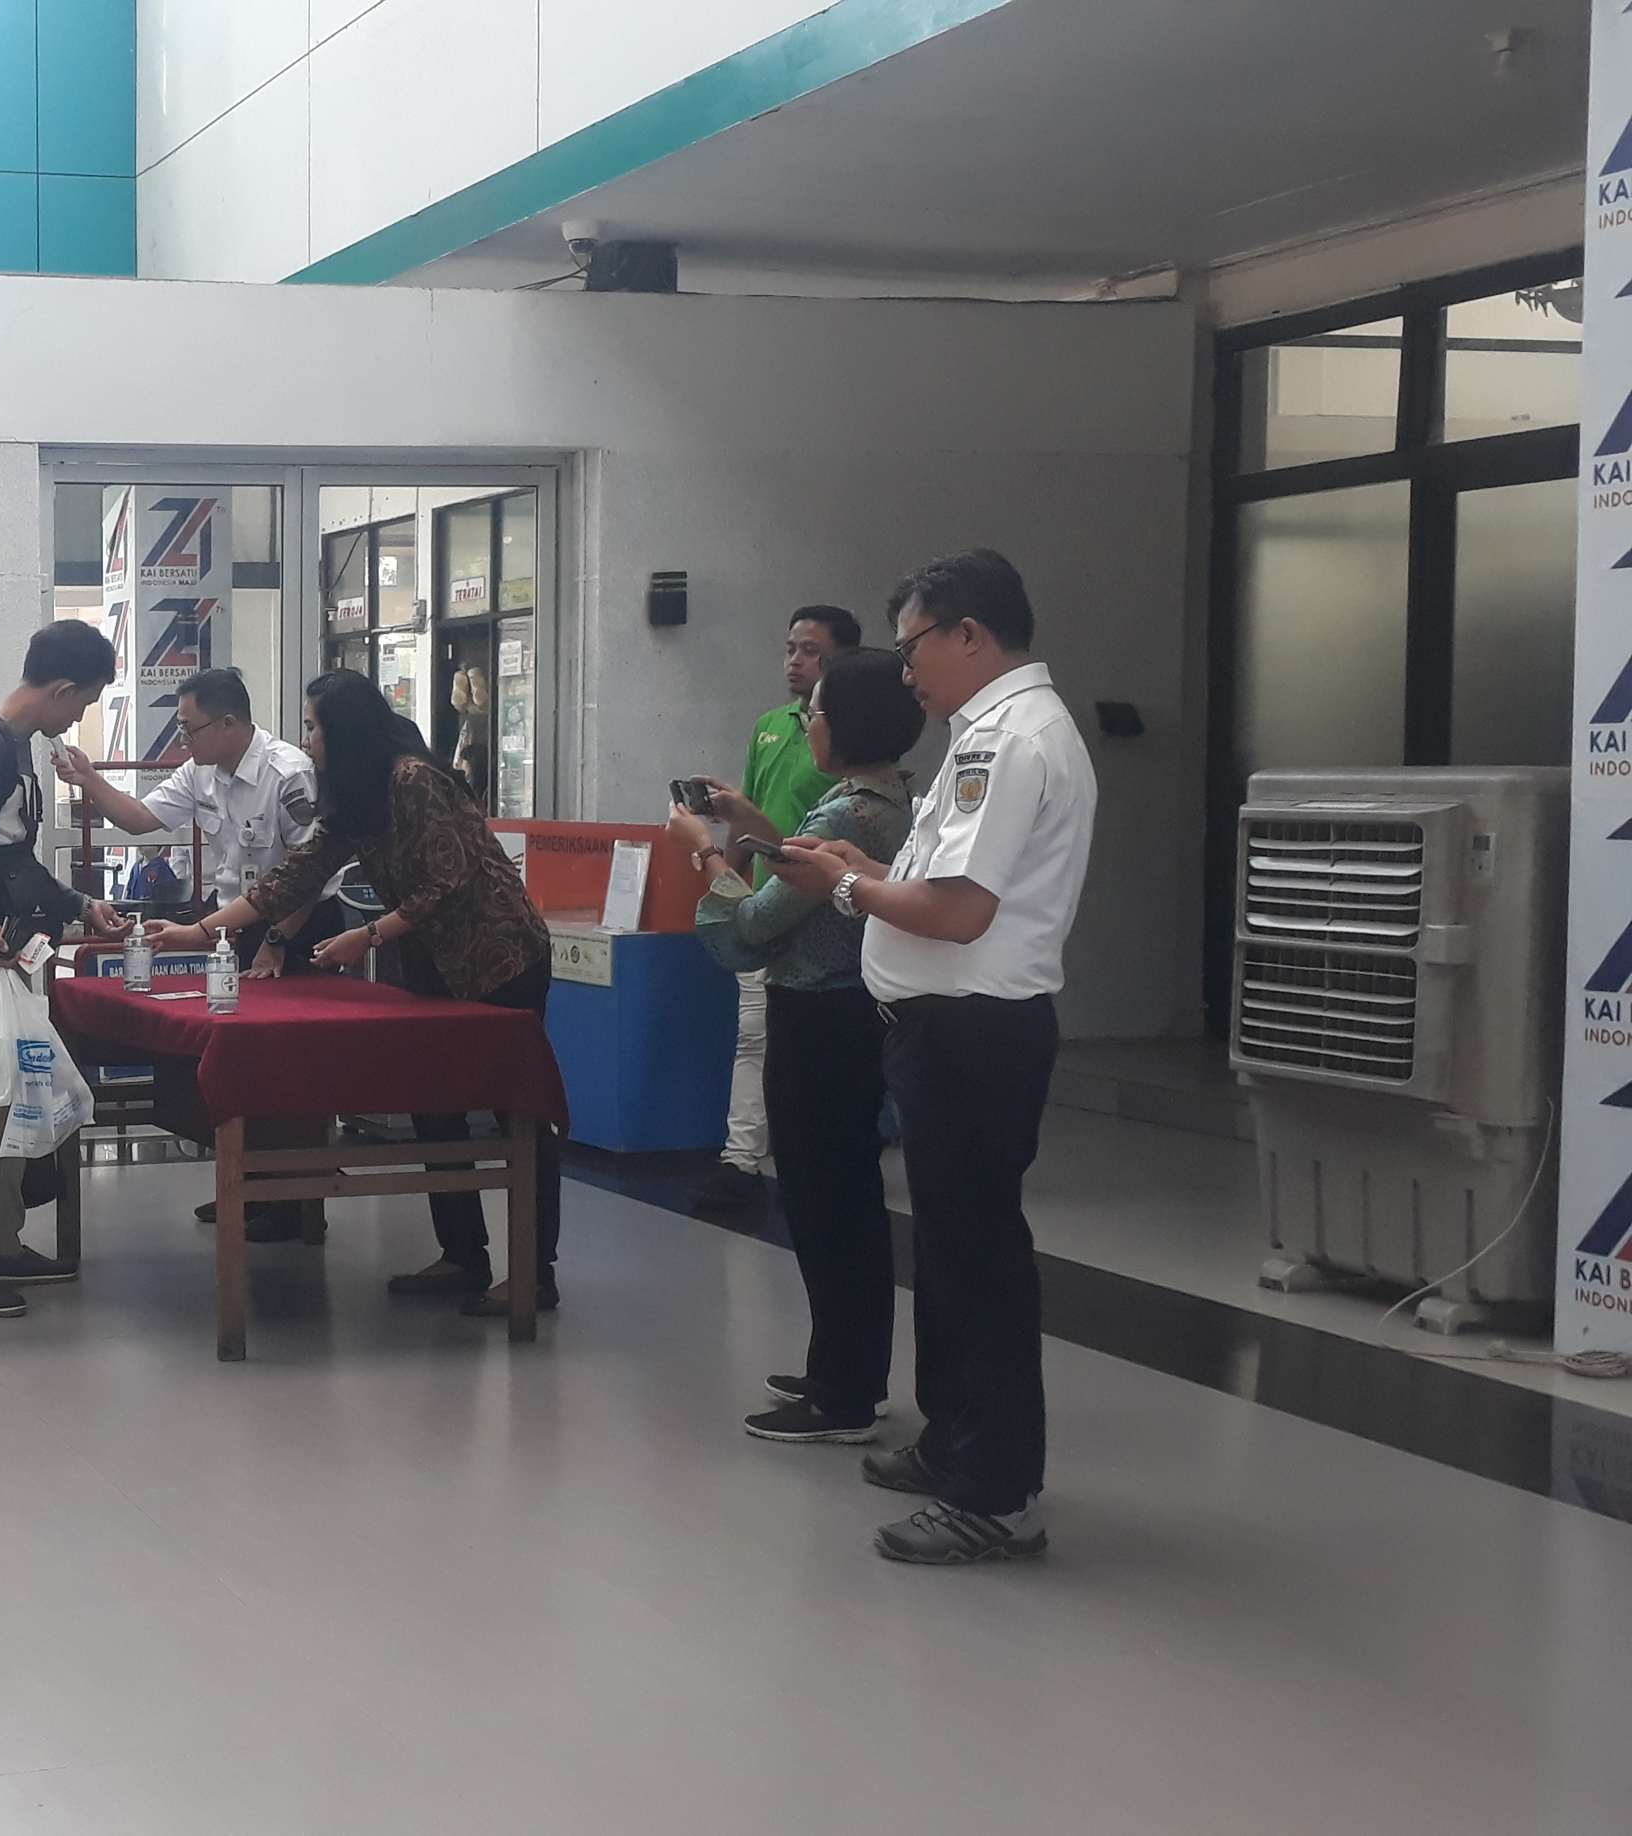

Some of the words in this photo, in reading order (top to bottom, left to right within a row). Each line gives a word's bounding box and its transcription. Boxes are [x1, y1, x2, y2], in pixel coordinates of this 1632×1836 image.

[1594, 459, 1631, 486] KAI
[140, 569, 156, 578] KAI
[159, 569, 198, 578] BERSATU
[455, 586, 482, 601] TERATAI
[339, 605, 363, 619] SEROJA
[141, 669, 156, 677] KAI
[1589, 730, 1626, 753] KAI
[528, 834, 609, 854] PEMERIKSAAN
[1585, 997, 1620, 1022] KAI
[1575, 1258, 1611, 1285] KAI
